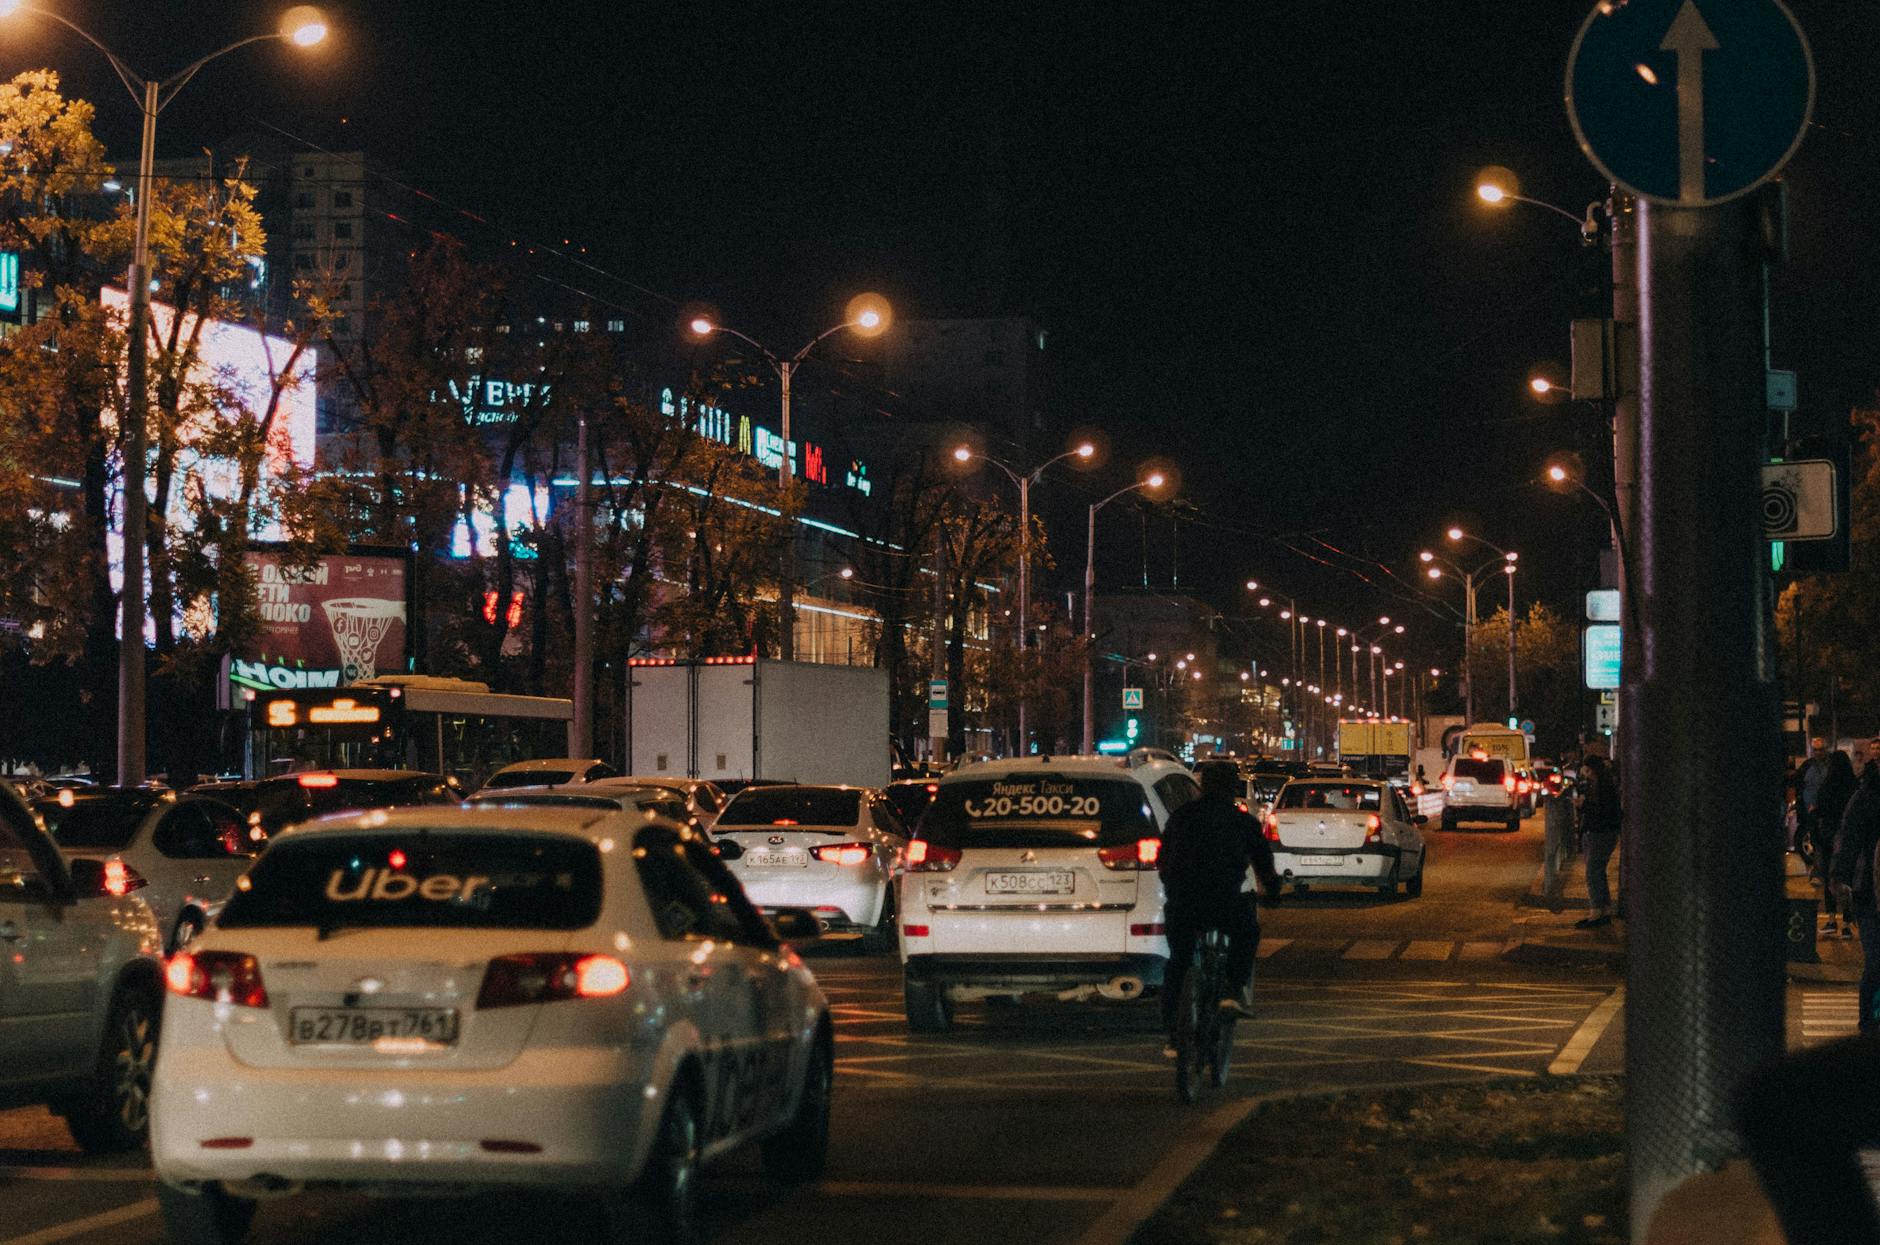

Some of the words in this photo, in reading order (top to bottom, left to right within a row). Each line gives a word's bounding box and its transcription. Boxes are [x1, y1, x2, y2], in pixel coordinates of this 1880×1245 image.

[993, 783, 1036, 796] Яндекс
[1040, 780, 1074, 795] Такси
[983, 796, 1100, 816] 20-500-20
[325, 868, 490, 902] Uber
